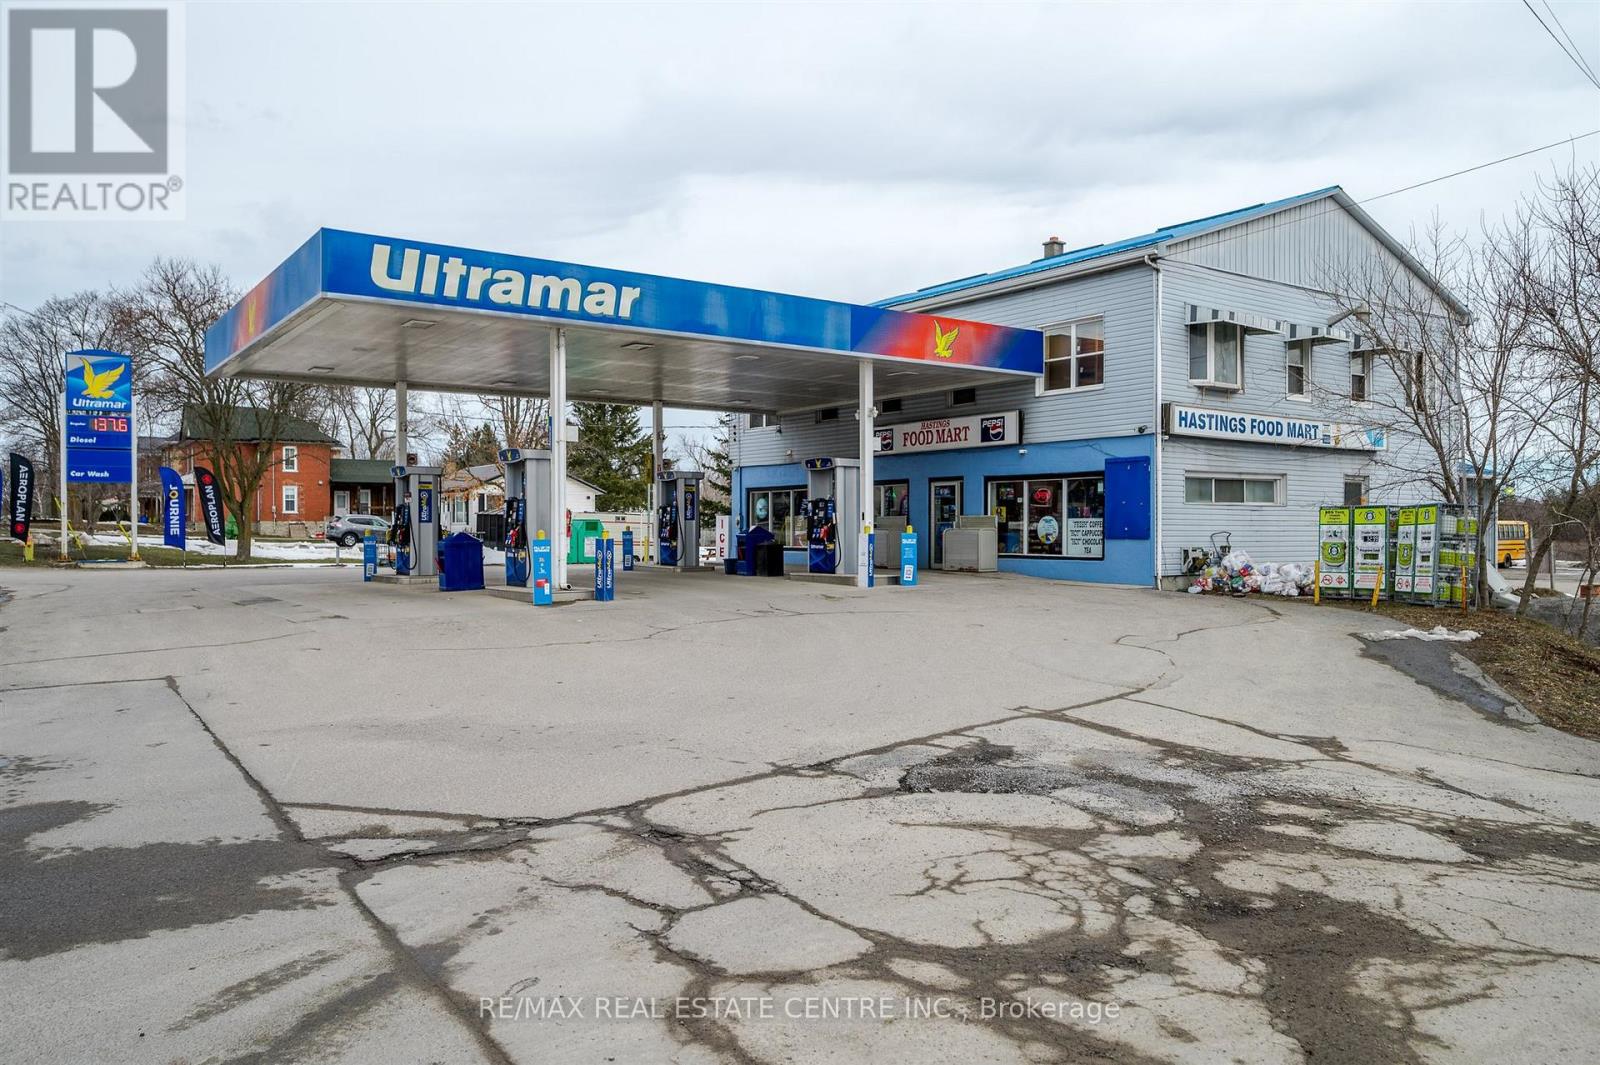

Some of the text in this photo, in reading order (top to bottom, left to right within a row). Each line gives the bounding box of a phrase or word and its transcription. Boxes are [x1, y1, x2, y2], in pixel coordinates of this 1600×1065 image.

[370, 243, 641, 320] Ultramar
[72, 398, 127, 409] Ultramar
[920, 419, 950, 430] HASTINGS
[982, 418, 1003, 428] PEPSI
[1178, 410, 1319, 440] HASTINGS FOOD MART
[902, 426, 970, 447] FOOD MART
[87, 470, 110, 478] Wash
[15, 464, 28, 522] AEROPLAN
[169, 484, 180, 536] JOURNIE
[204, 485, 221, 536] AEROPLAN
